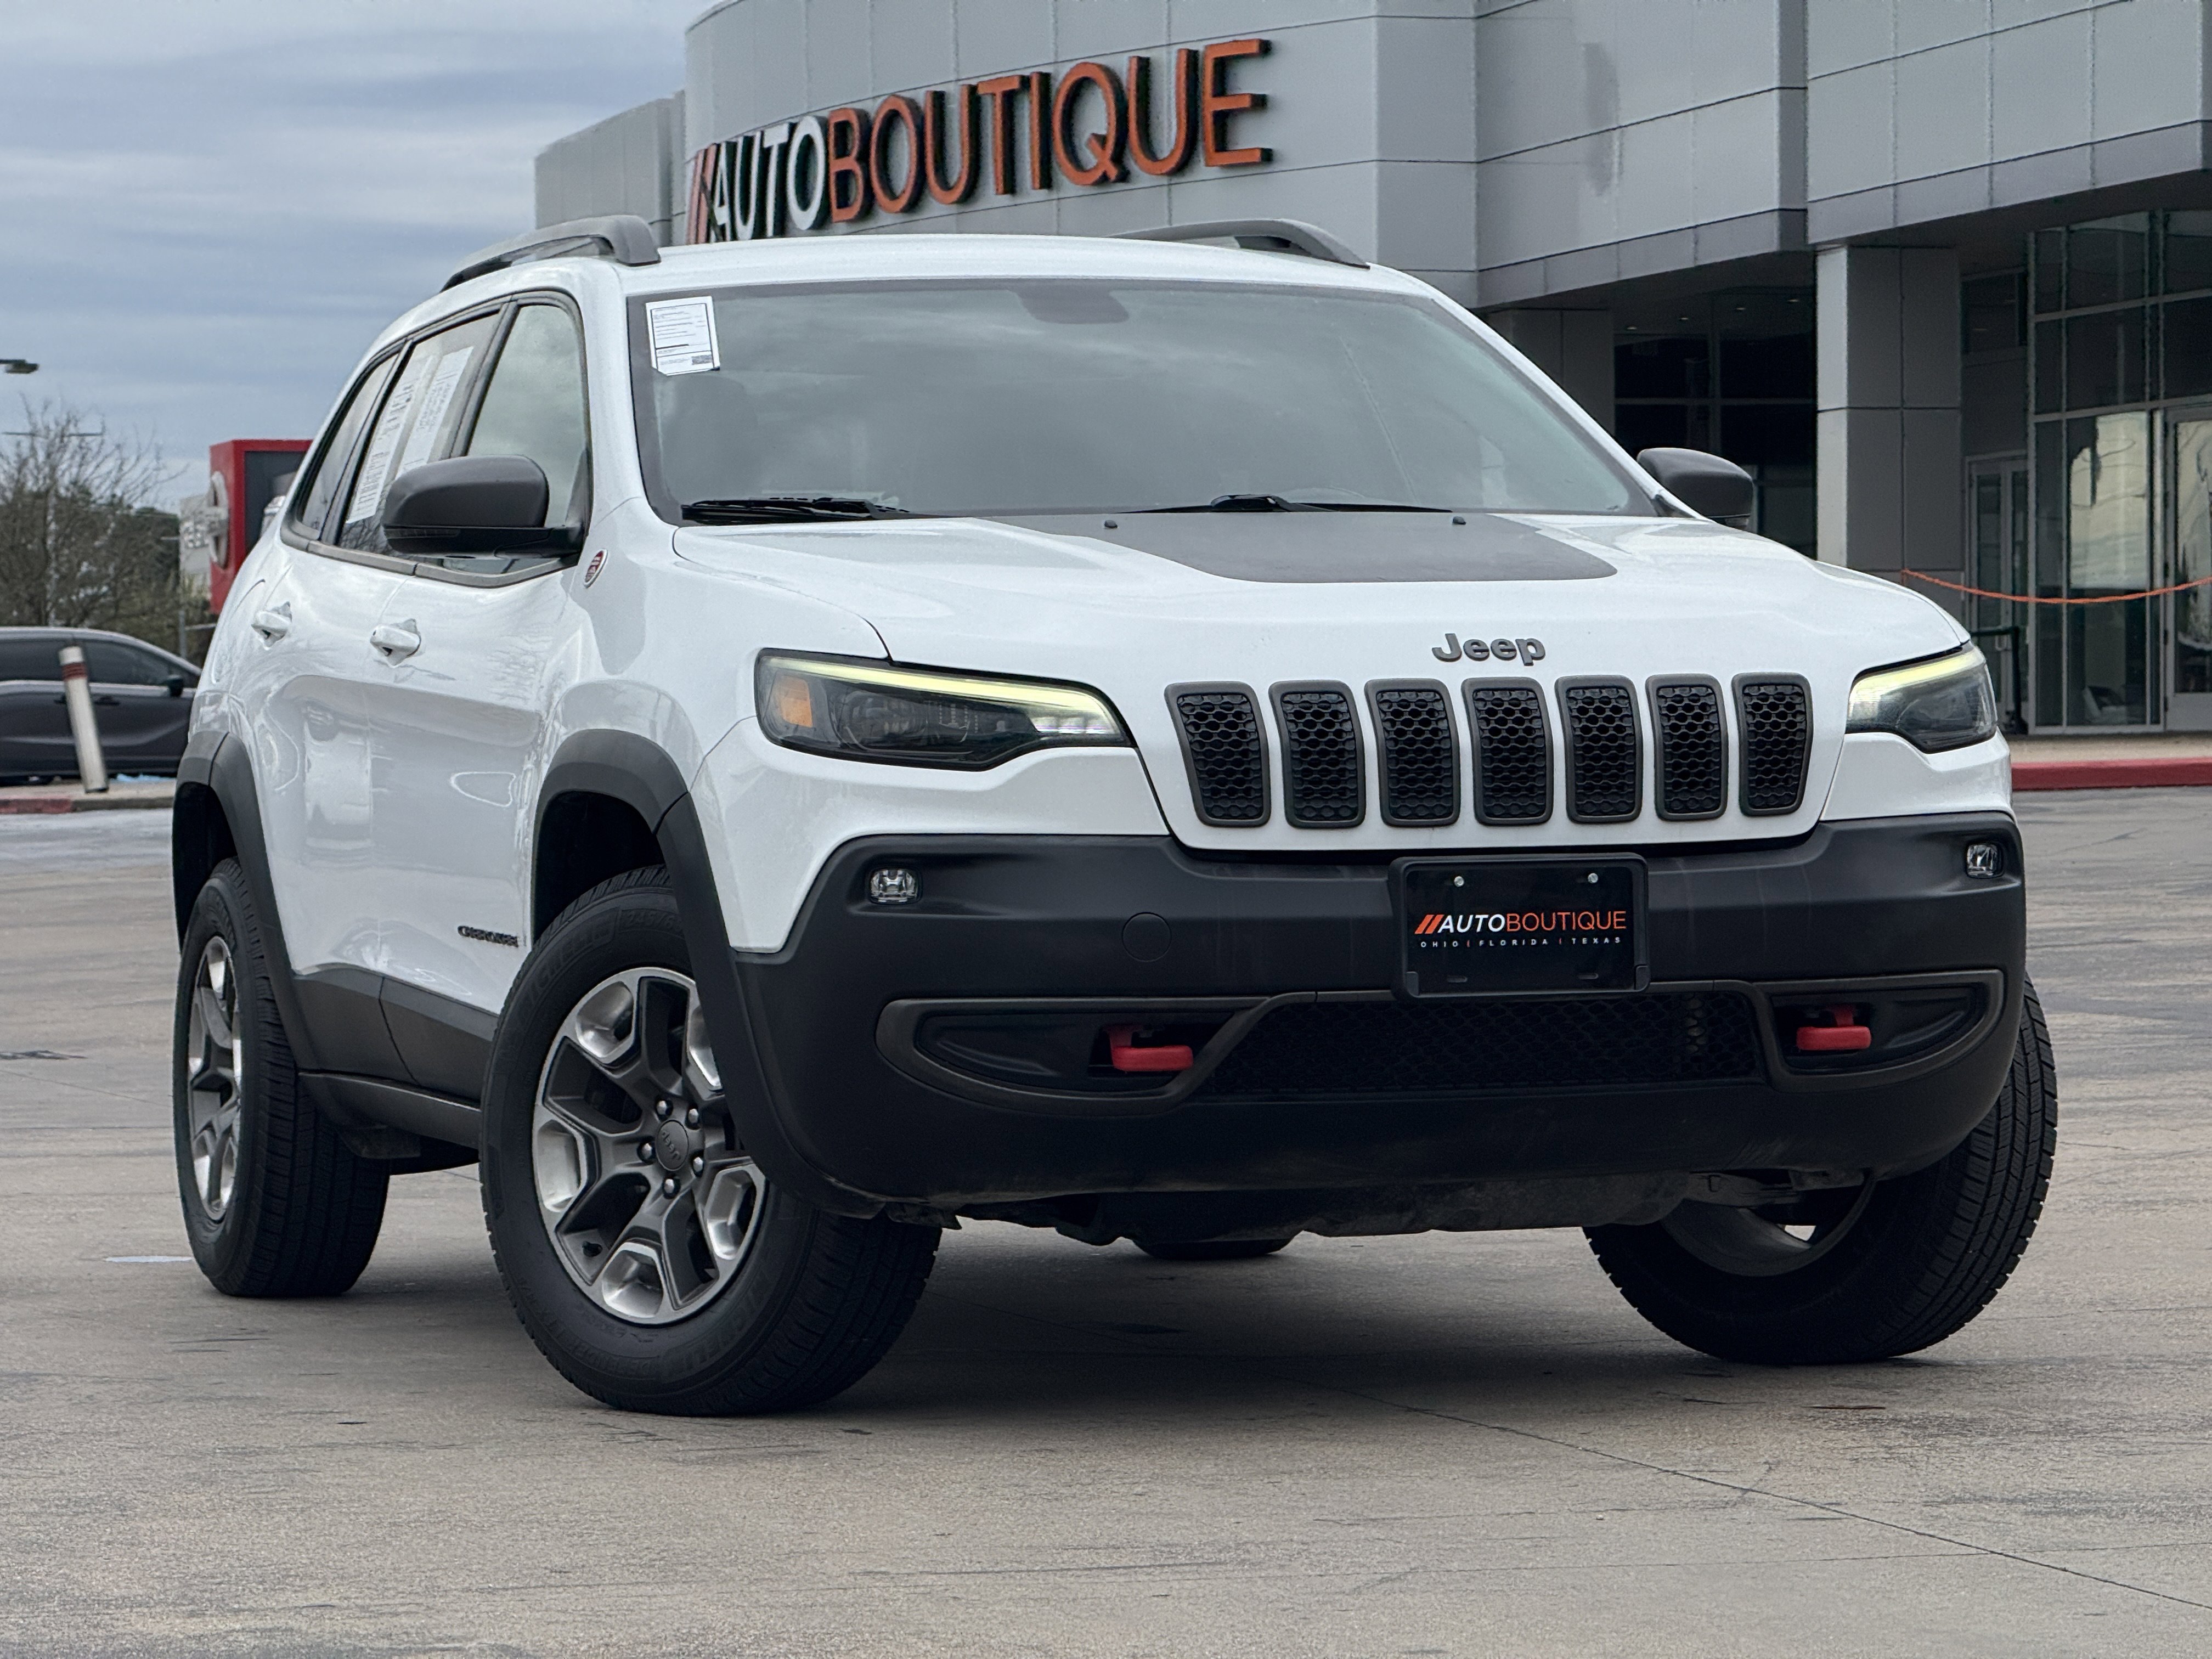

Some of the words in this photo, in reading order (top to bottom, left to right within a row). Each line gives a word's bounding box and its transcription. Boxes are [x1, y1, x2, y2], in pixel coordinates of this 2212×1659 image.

[708, 38, 1271, 241] AUTOBOUTIQUE
[1431, 633, 1546, 666] Jeep
[1437, 911, 1627, 933] AUTOBOUTIQUE
[1479, 939, 1549, 947] FLORIDA
